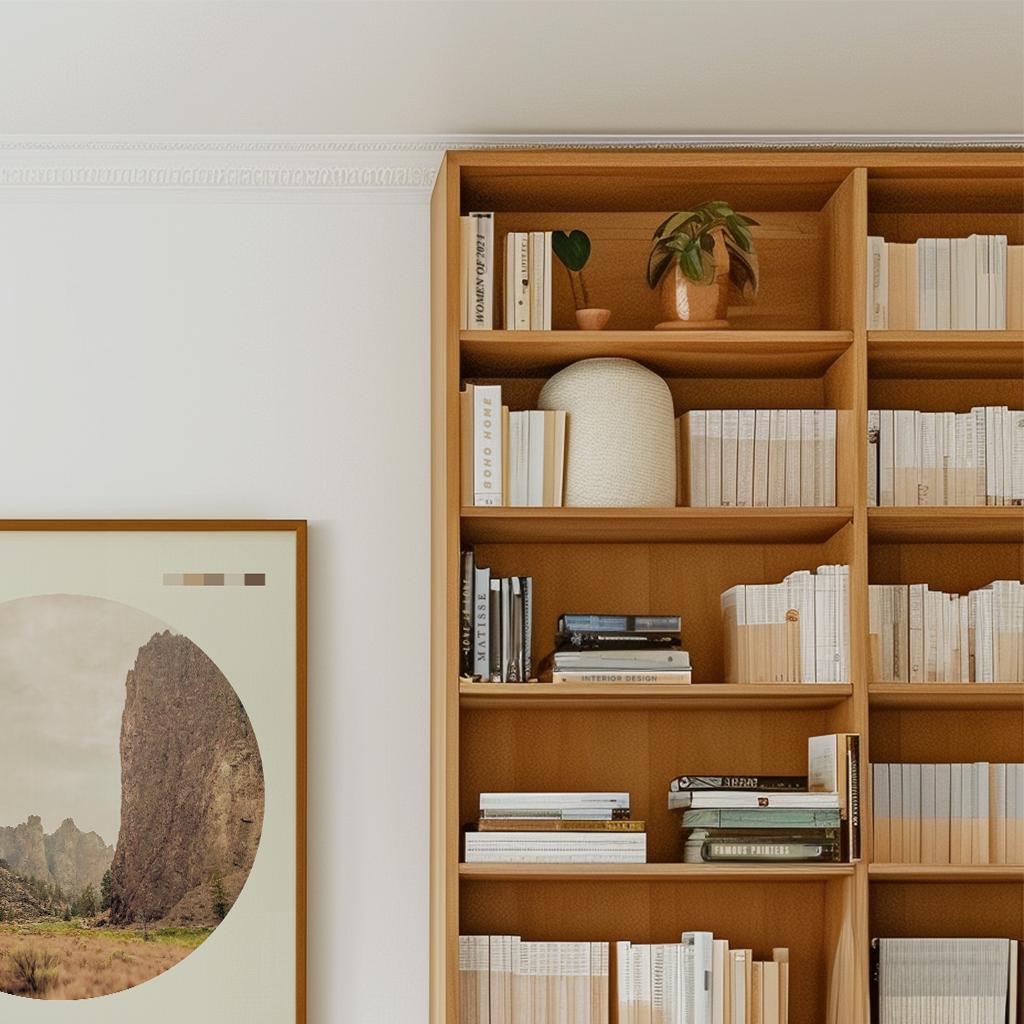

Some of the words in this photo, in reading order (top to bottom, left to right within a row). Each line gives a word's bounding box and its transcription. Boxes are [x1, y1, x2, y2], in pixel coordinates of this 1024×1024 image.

[474, 233, 485, 258] 2024
[474, 258, 485, 276] OF
[474, 277, 485, 323] WOMEN
[483, 397, 492, 439] HOME
[483, 447, 492, 489] BOHO
[477, 593, 486, 661] MATISSE
[714, 845, 748, 855] FAMOUS
[751, 845, 790, 855] PAINTERS
